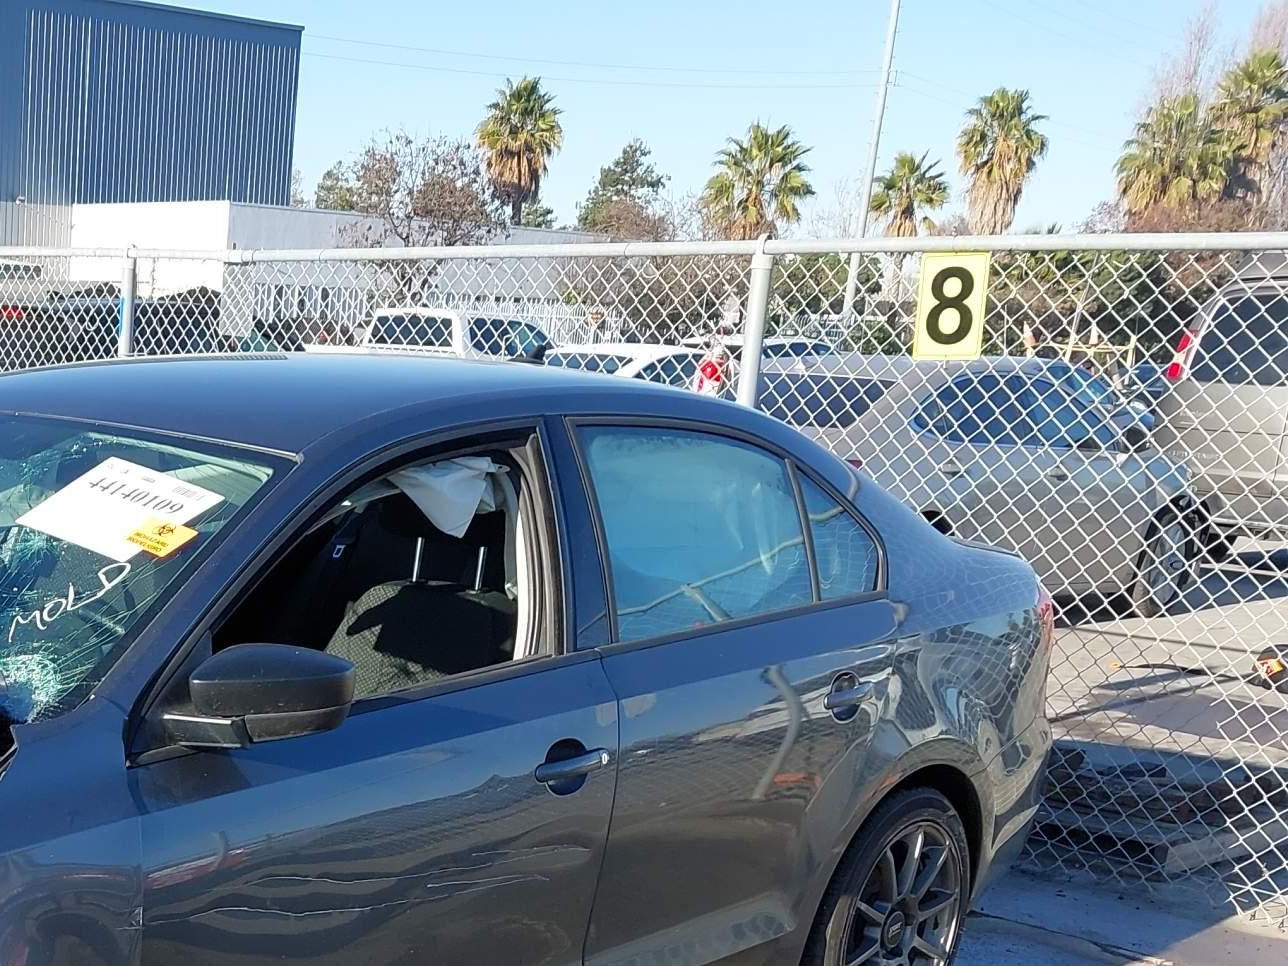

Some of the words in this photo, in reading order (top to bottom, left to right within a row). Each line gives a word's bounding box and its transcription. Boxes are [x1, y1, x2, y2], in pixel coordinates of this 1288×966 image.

[925, 266, 975, 345] 8
[88, 477, 185, 514] 44140109
[8, 562, 132, 643] MOLD
